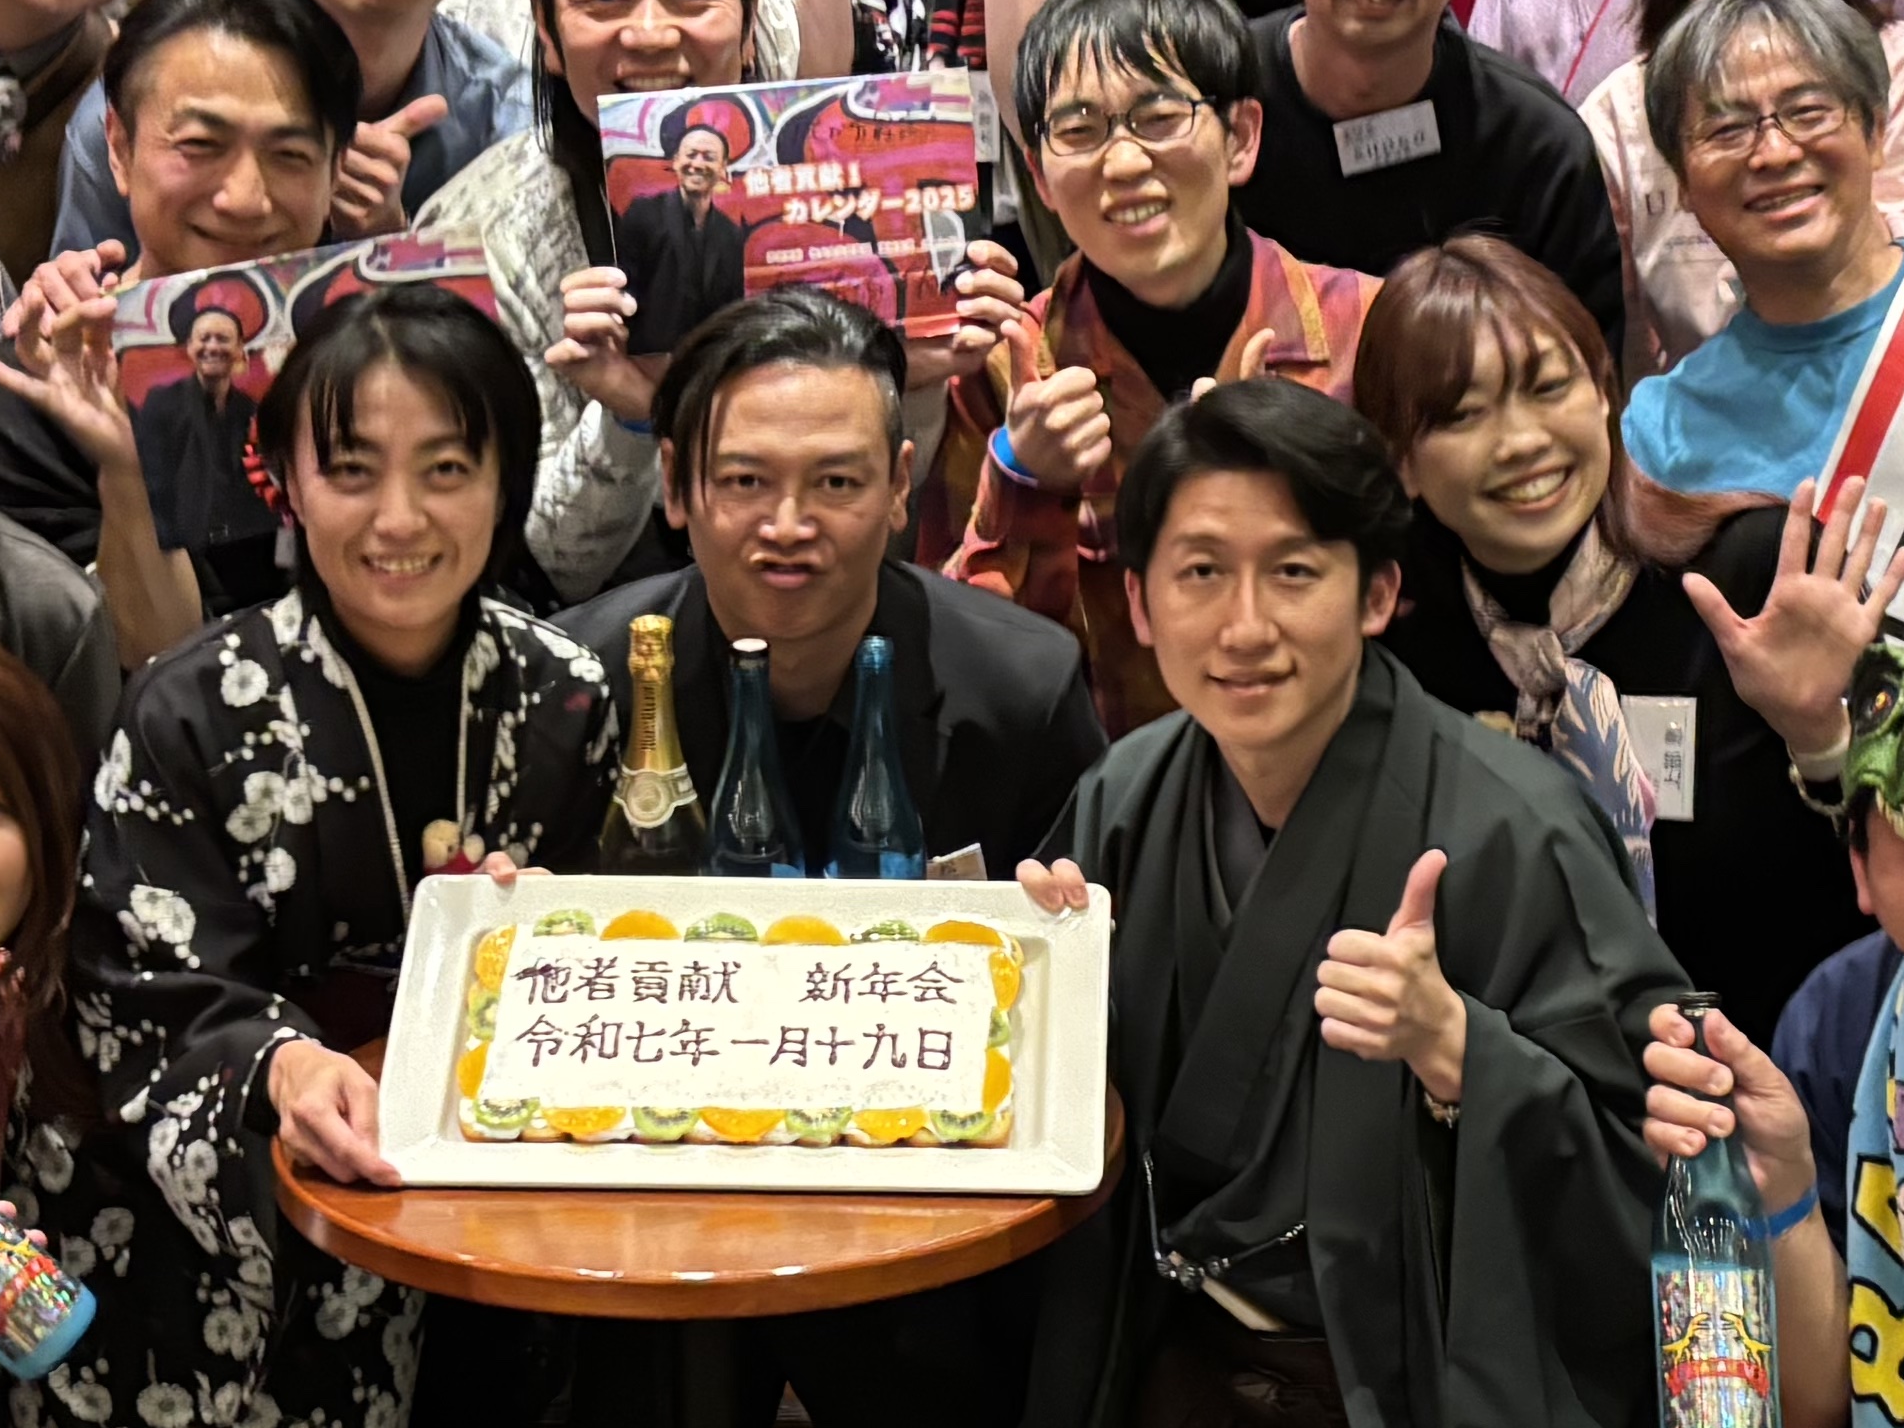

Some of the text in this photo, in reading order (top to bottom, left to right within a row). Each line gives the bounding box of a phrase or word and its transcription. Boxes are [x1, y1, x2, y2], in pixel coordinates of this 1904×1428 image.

[782, 184, 977, 225] カレンダー2025
[515, 957, 964, 1006] 他者貢献 新年会
[515, 1013, 956, 1072] 令和七年一月十九日
